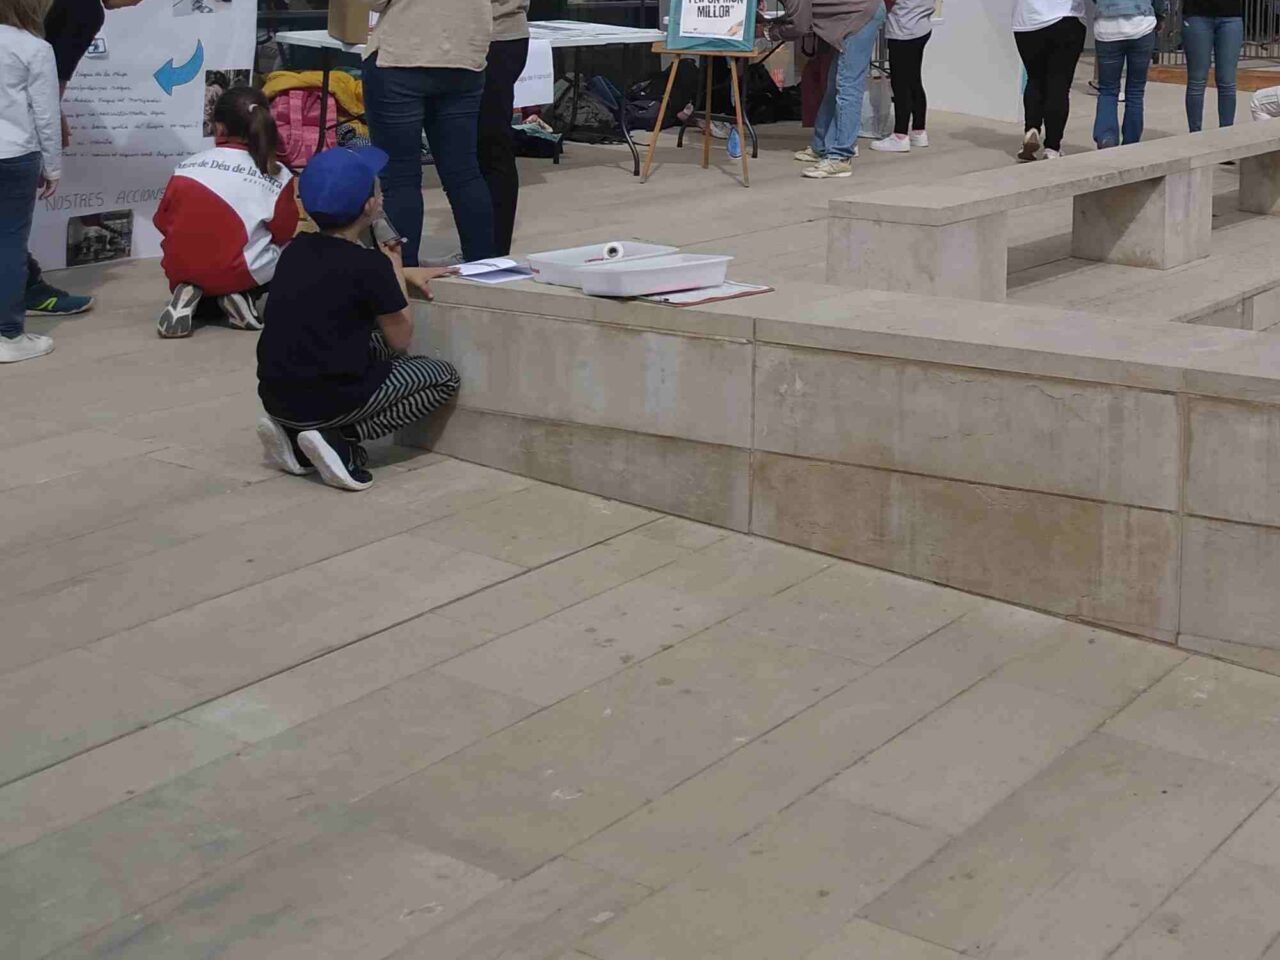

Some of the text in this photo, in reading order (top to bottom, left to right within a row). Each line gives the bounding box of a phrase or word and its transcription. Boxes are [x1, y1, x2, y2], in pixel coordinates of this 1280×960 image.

[210, 160, 230, 171] Déu
[232, 165, 246, 174] de
[247, 166, 257, 177] la
